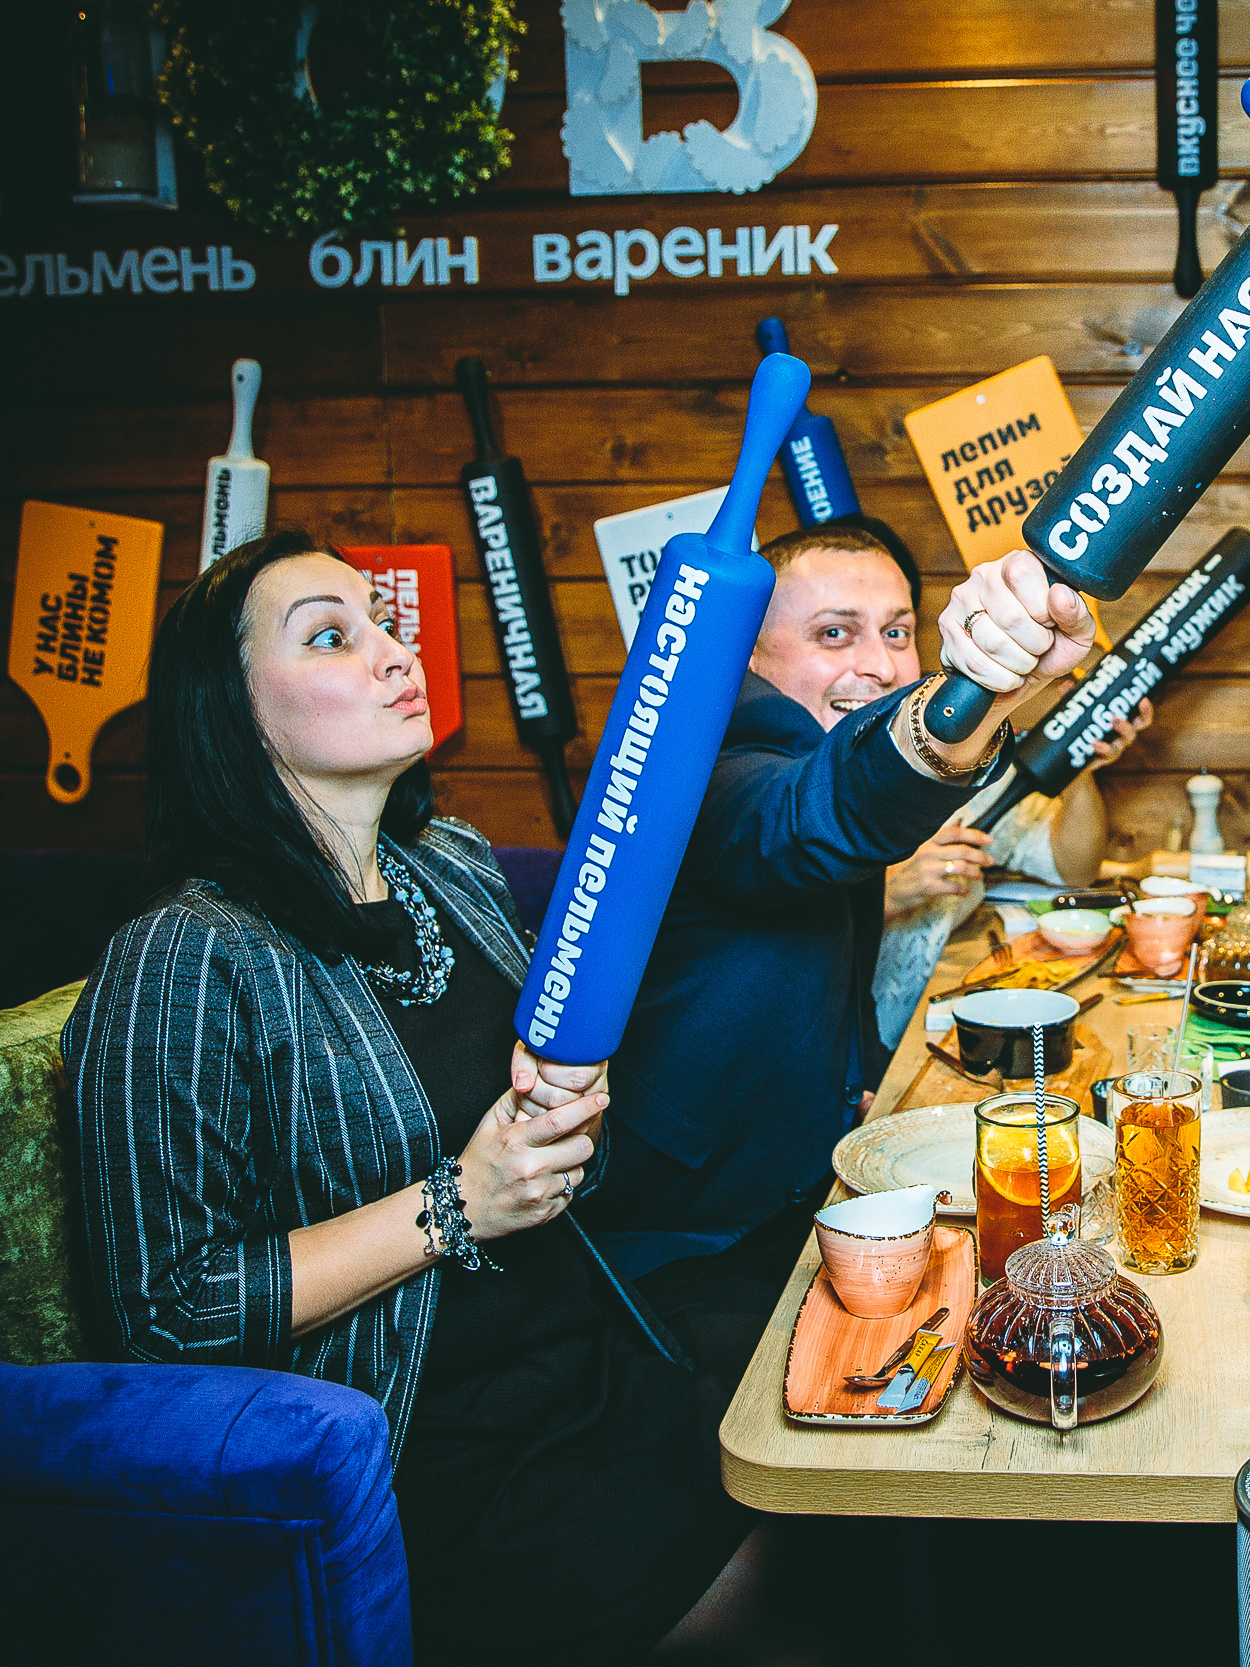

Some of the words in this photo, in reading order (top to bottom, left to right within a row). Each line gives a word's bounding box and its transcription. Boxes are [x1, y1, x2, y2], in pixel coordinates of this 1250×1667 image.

[309, 230, 480, 288] блин
[532, 223, 839, 296] вареник
[789, 435, 834, 523] ОЕНИЕ
[941, 413, 1042, 472] лепим
[954, 458, 1014, 505] для
[1048, 364, 1208, 561] СОЗДАЙ
[36, 593, 62, 653] НАС
[57, 572, 89, 682] БЛИНЫ
[86, 534, 119, 645] КОМОМ
[469, 475, 549, 719] ВАРЕНИЧНАЯ
[1125, 569, 1210, 655] мужик
[1161, 574, 1245, 664] мужик
[33, 656, 54, 675] У
[80, 647, 105, 687] НЕ
[597, 563, 710, 834] настоящий
[528, 833, 616, 1047] пельмень
